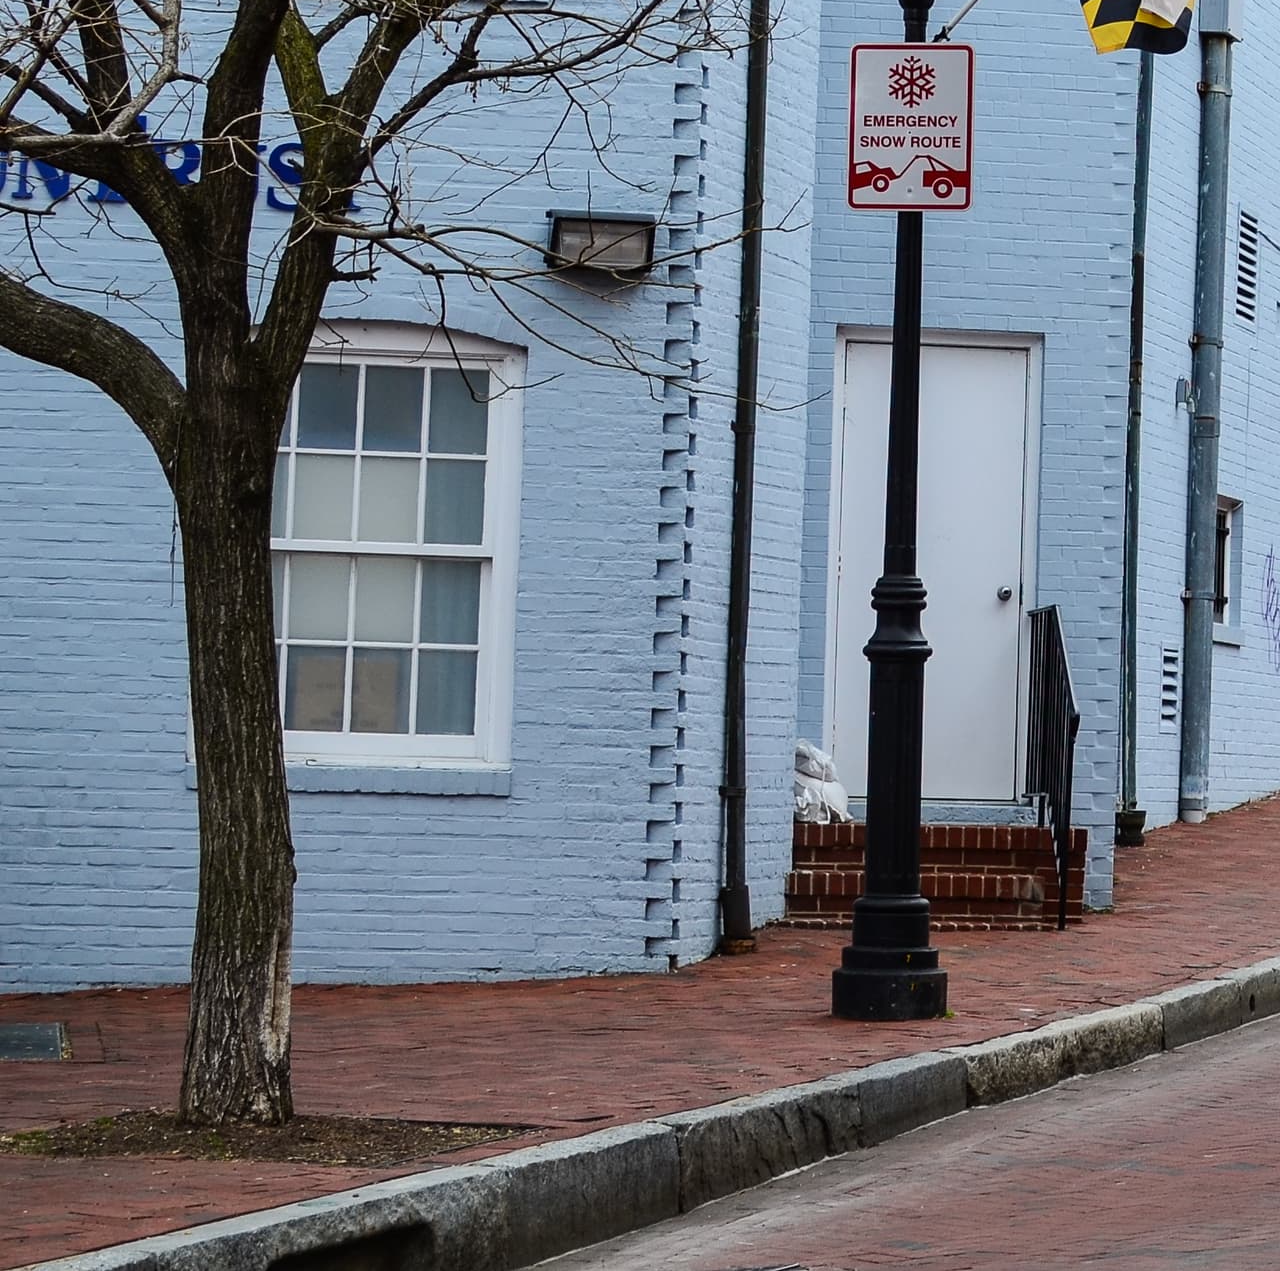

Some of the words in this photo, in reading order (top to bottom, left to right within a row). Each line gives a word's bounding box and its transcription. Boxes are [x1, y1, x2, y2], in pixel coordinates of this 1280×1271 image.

[863, 115, 958, 127] EMERGENCY
[860, 136, 906, 148] SNOW
[910, 136, 961, 148] ROUTE
